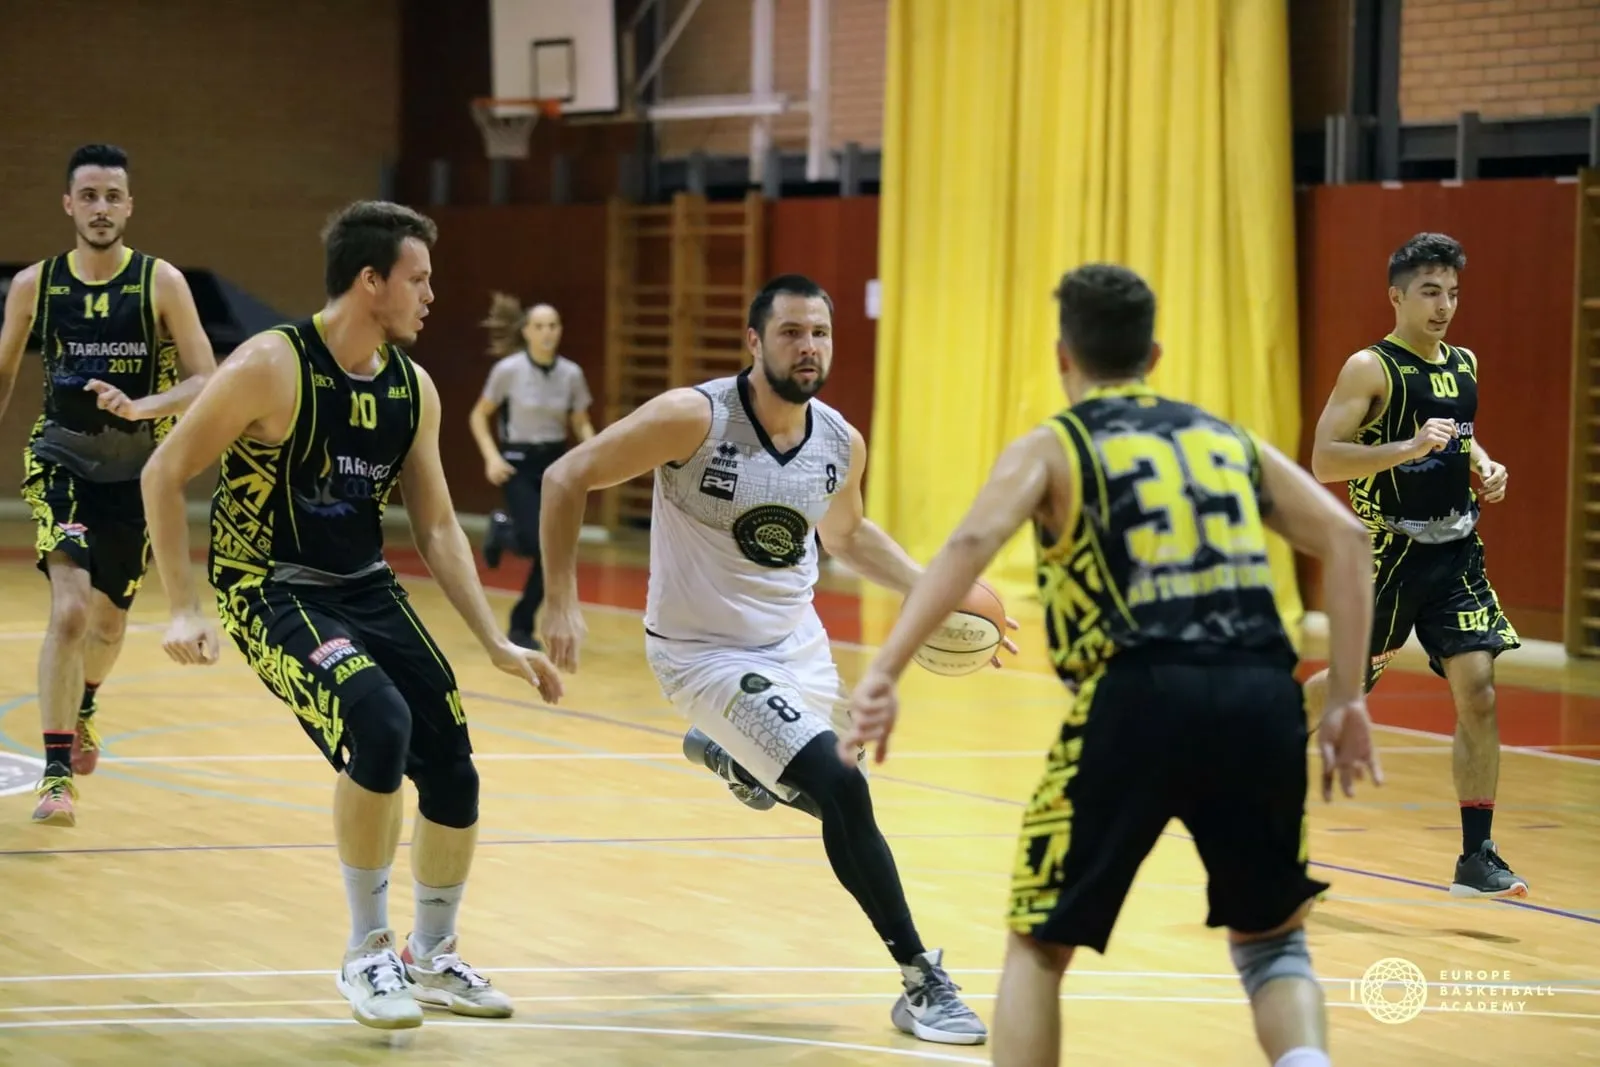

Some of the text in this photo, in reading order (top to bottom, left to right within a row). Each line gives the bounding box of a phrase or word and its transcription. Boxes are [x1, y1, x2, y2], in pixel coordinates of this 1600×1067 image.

[84, 292, 109, 318] 14
[67, 342, 148, 356] TARRAGONA
[108, 359, 142, 373] 2017
[1430, 371, 1459, 398] 00
[349, 390, 377, 429] 10
[702, 474, 735, 493] 24
[826, 463, 837, 493] 8
[1096, 427, 1265, 568] 35
[1457, 607, 1489, 632] 00
[767, 695, 801, 723] 8
